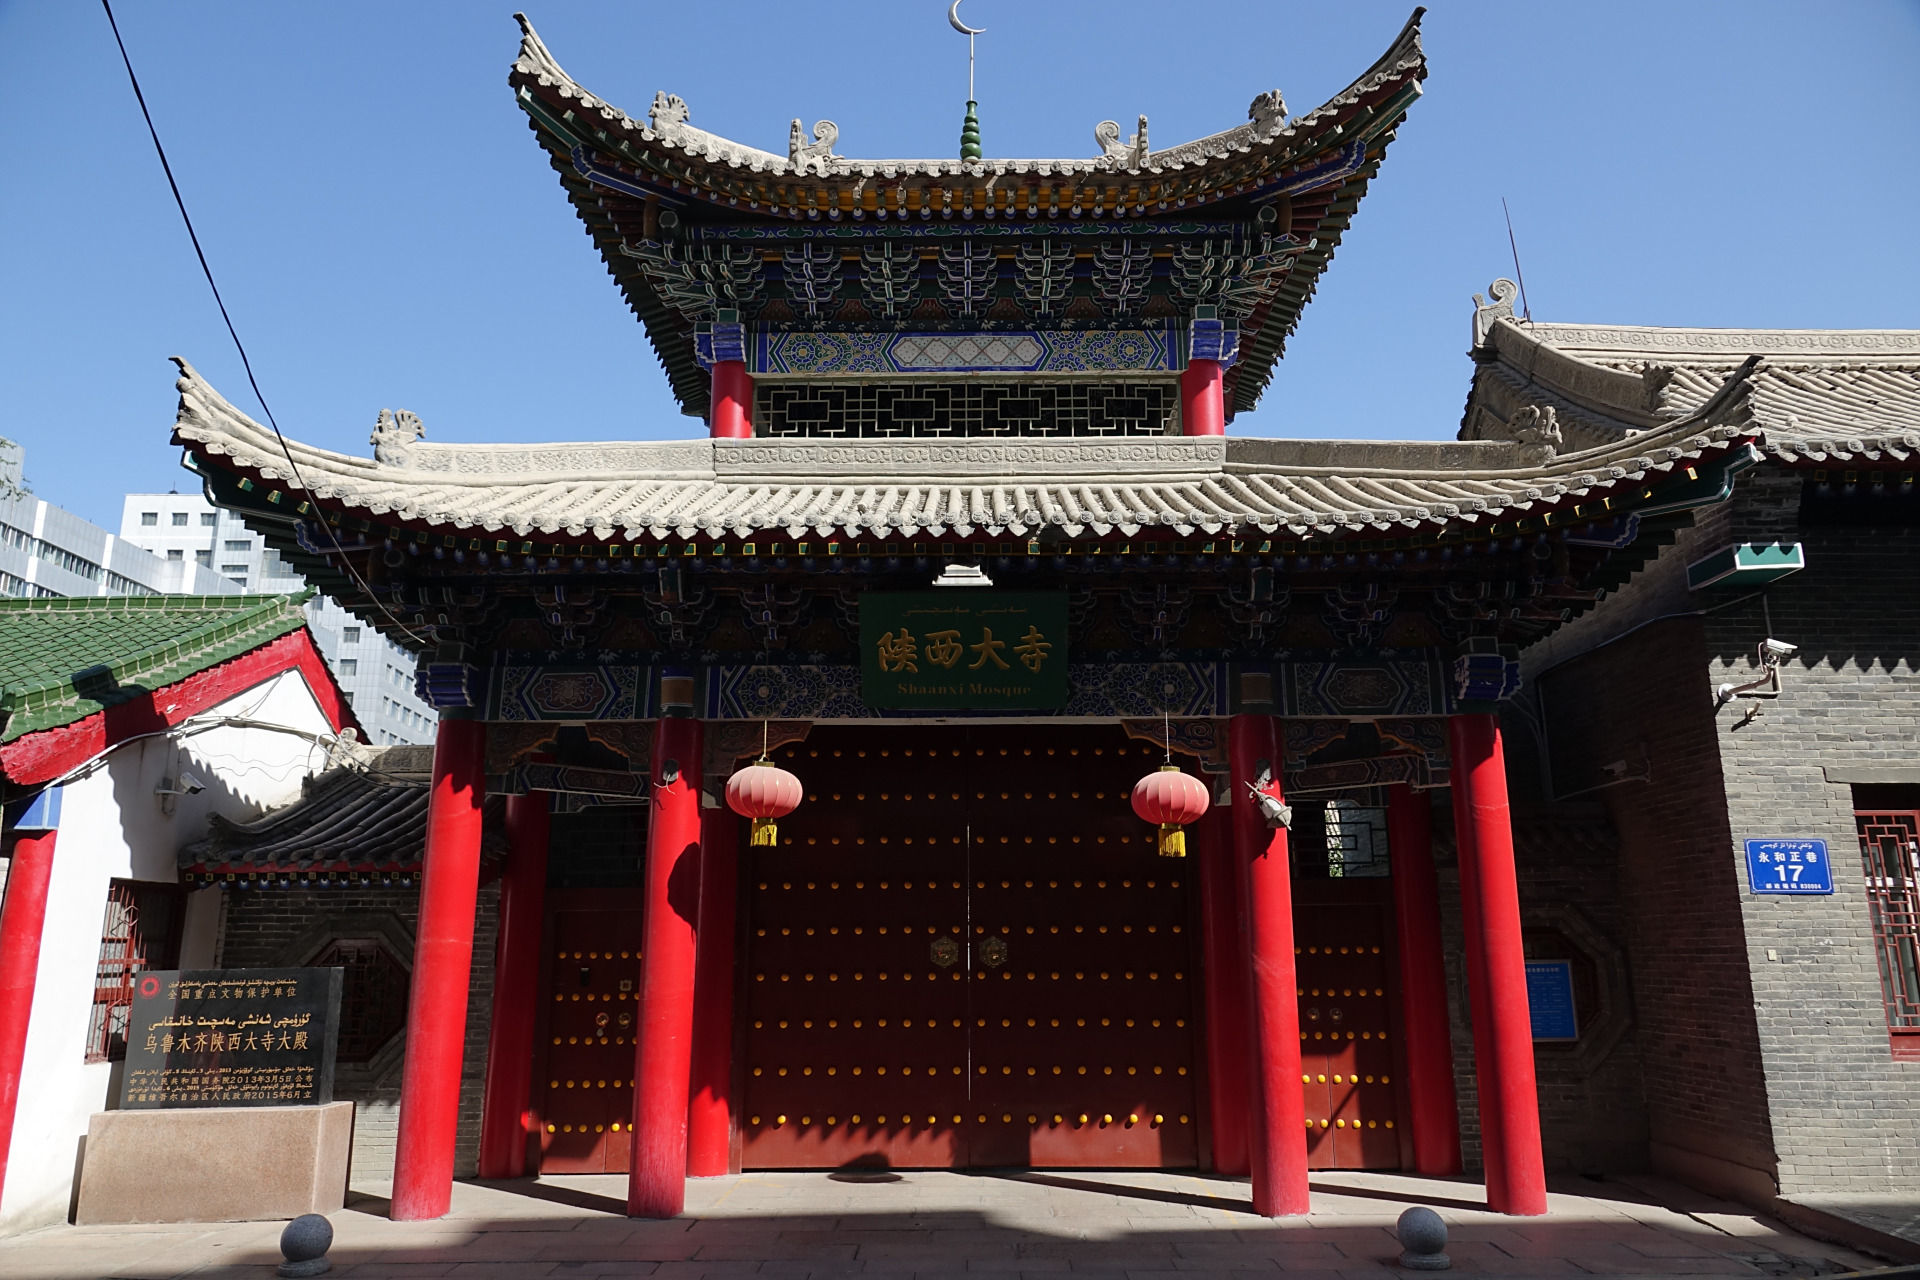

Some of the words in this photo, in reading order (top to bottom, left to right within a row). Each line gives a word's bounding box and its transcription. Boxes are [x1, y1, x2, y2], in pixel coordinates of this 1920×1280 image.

[877, 626, 1052, 674] 陕西大寺
[898, 683, 964, 695] Shaanxi
[970, 683, 1031, 697] Mosque
[1758, 852, 1817, 862] 永和正巷
[1774, 865, 1803, 881] 17
[167, 987, 297, 1000] 全国重点文物保护单位
[144, 1031, 308, 1053] 乌鲁木齐陕西大寺大殿
